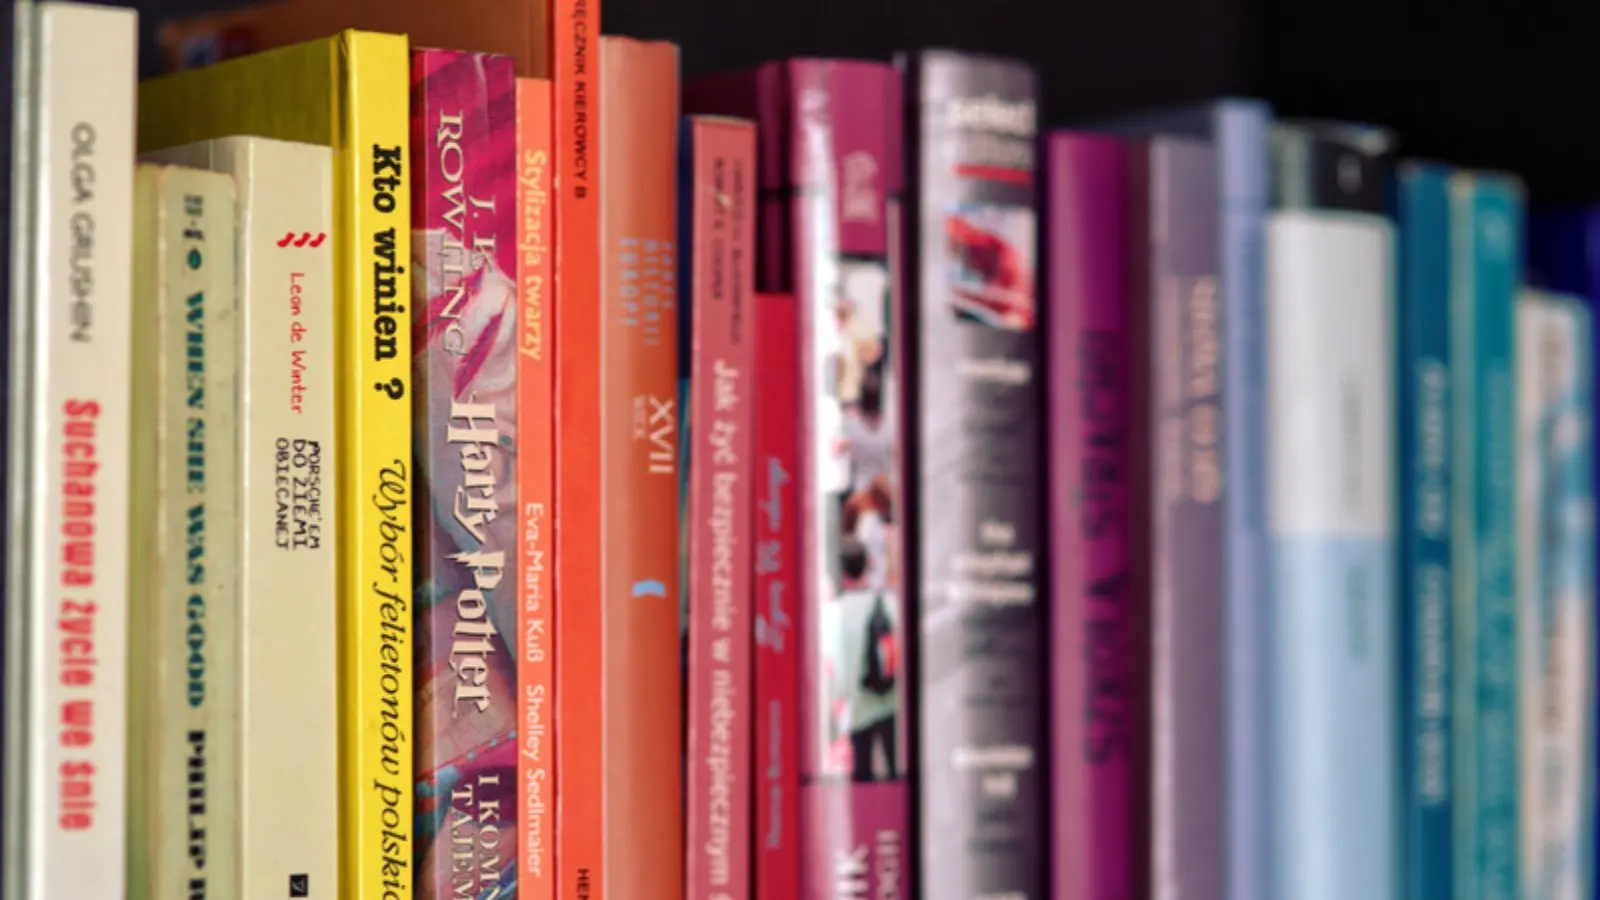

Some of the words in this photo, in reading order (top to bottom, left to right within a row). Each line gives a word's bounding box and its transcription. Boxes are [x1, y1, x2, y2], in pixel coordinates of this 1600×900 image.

[70, 122, 97, 204] OLGA
[574, 81, 589, 181] KIEROWCY
[372, 143, 402, 214] Kto
[520, 148, 547, 266] Stylizacja
[574, 186, 588, 199] B
[68, 212, 96, 343] GRUSHIN
[436, 108, 467, 357] ROWLING
[290, 272, 305, 316] Leon
[291, 321, 308, 343] de
[373, 227, 405, 362] winien
[519, 273, 543, 360] twarzy
[186, 291, 205, 410] WHEN
[290, 350, 308, 414] Winter
[374, 377, 405, 401] ?
[713, 359, 740, 411] Jak
[186, 418, 205, 495] SHE
[292, 438, 307, 469] DO
[447, 391, 499, 545] Harry
[649, 394, 675, 474] XVII
[61, 398, 101, 587] Suchanowa
[275, 437, 290, 551] OBIECANEJ
[292, 477, 308, 551] ZIEMI
[372, 459, 407, 583] Wybór
[186, 502, 205, 585] WAS
[525, 502, 546, 612] Eva-Maria
[708, 472, 738, 632] bezpiecznie
[187, 594, 205, 708] GOOD
[372, 580, 407, 776] felietonów
[444, 551, 505, 717] Potter
[711, 637, 731, 664] w
[60, 699, 95, 748] we
[523, 684, 545, 761] Shelley
[187, 730, 207, 871] PHILIP
[477, 773, 499, 786] I
[526, 768, 545, 877] Sedlmaier
[705, 669, 736, 886] niebezpiecznym
